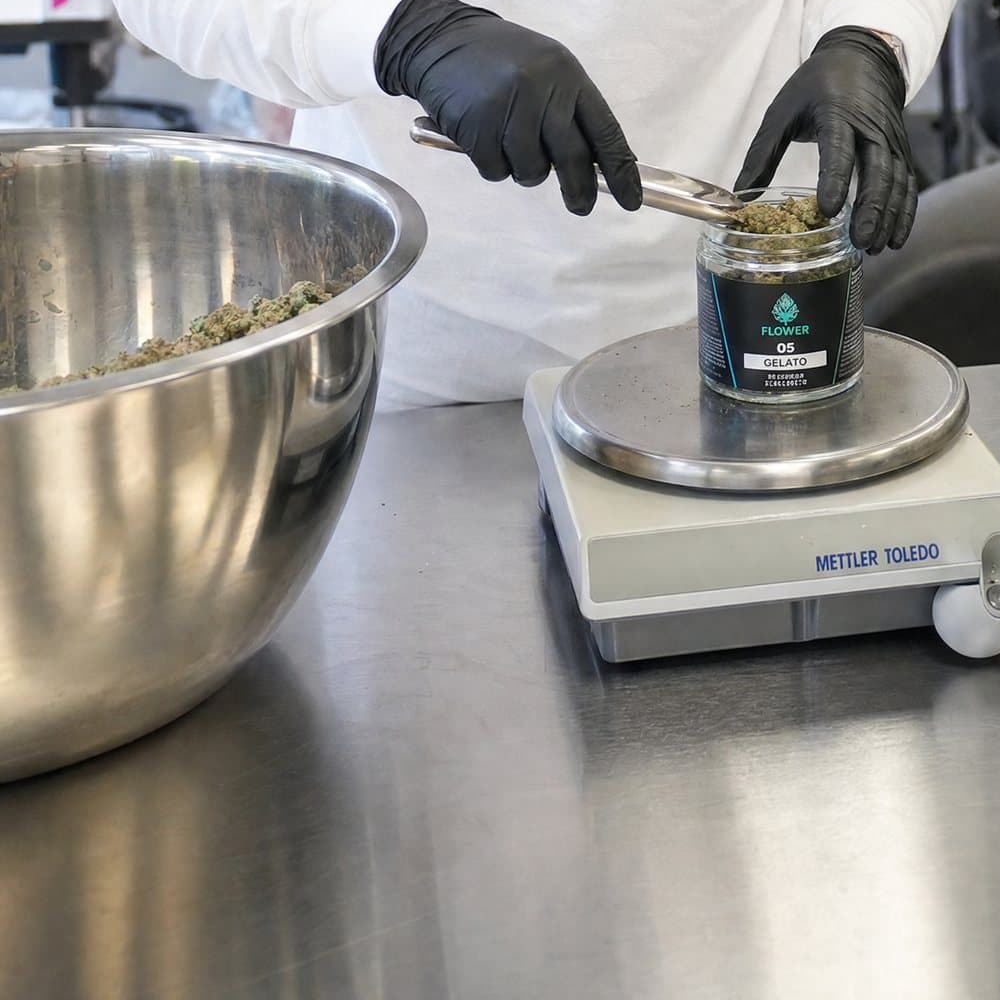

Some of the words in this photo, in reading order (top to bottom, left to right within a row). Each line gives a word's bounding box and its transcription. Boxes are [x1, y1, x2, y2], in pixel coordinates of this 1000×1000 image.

[761, 325, 809, 336] FLOWER
[776, 342, 795, 354] 05
[763, 357, 807, 368] GELATO
[815, 549, 879, 572] METTLER
[883, 543, 940, 564] TOLEDO
